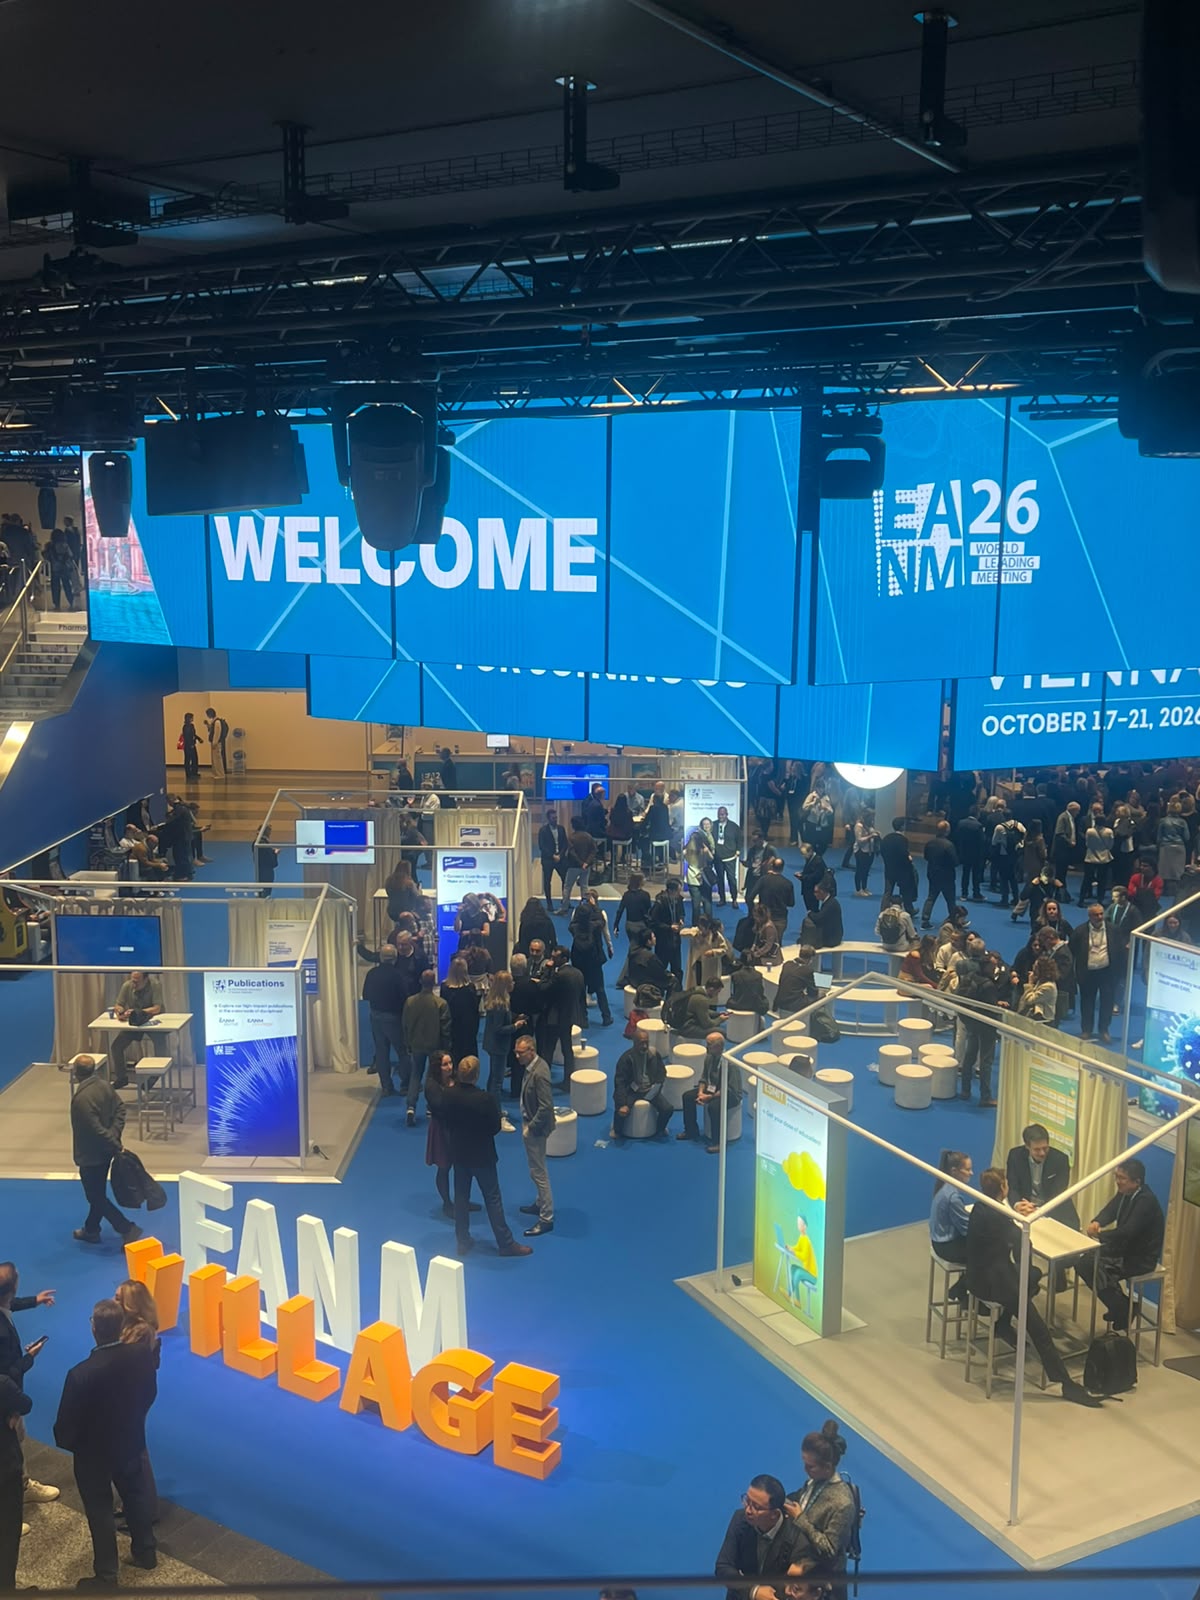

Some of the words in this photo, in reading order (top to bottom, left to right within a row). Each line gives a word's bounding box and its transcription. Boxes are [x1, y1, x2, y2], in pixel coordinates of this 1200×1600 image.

[969, 479, 1040, 534] 26
[213, 516, 598, 592] WELCOME
[975, 543, 1019, 554] WORLD
[984, 557, 1035, 569] LEADING
[976, 571, 1028, 583] MEETING
[981, 711, 1087, 736] OCTOBER
[1158, 706, 1200, 726] 2026
[227, 979, 285, 988] Publications
[124, 1236, 562, 1480] VILLAGE
